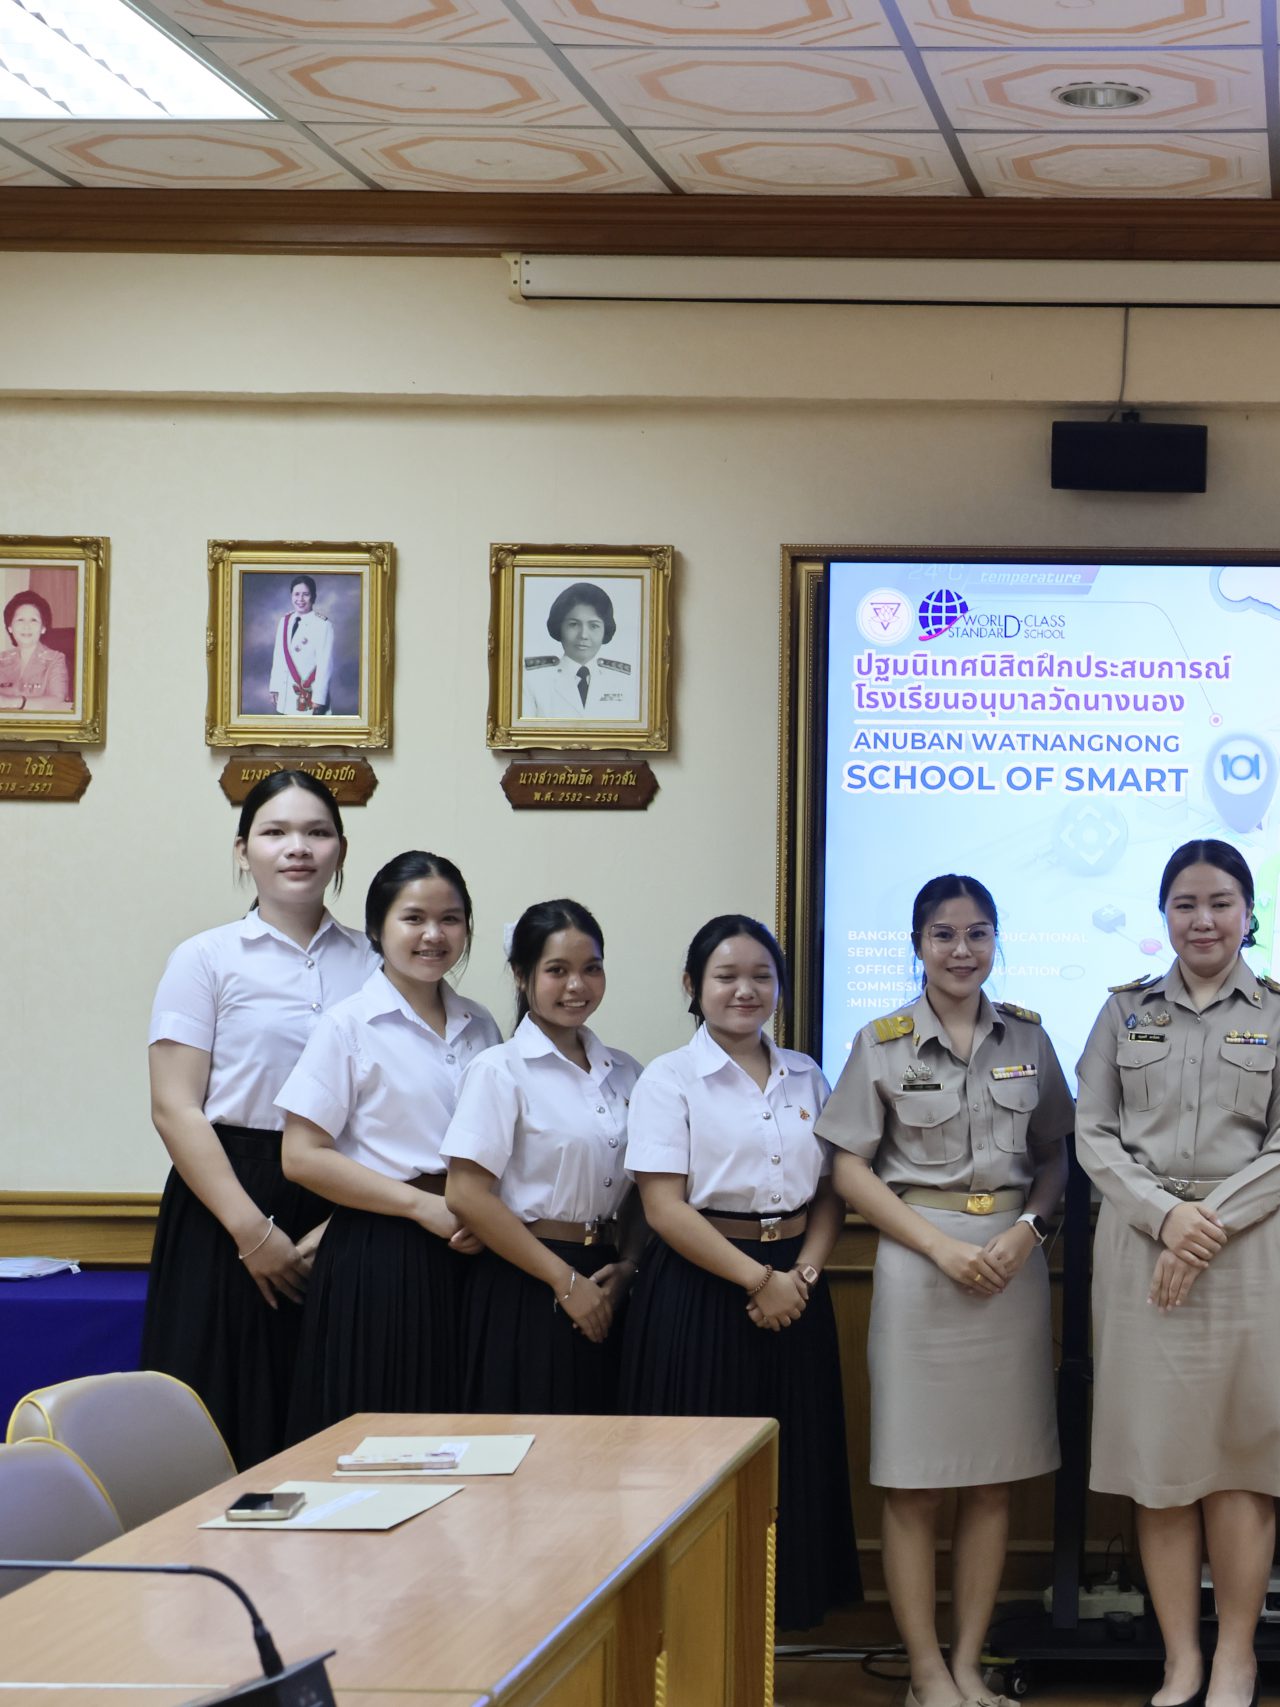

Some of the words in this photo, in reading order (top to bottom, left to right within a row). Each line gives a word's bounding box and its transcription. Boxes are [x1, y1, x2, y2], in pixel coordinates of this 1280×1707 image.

[980, 572, 1082, 585] temperature
[1024, 630, 1066, 639] SCHOOL
[856, 653, 1231, 682] ปฐมนิเทศนิสิตฝึกประสบการณ์
[856, 684, 1185, 716] โรงเรียนอนุบาลวัดนางนอง
[855, 731, 963, 751] ANUBAN
[971, 733, 1180, 753] WATNANGNONG
[847, 764, 995, 790] SCHOOL
[1006, 766, 1055, 791] OF
[1065, 767, 1189, 792] SMART
[848, 947, 906, 958] SERVICE
[855, 964, 905, 975] OFFICE
